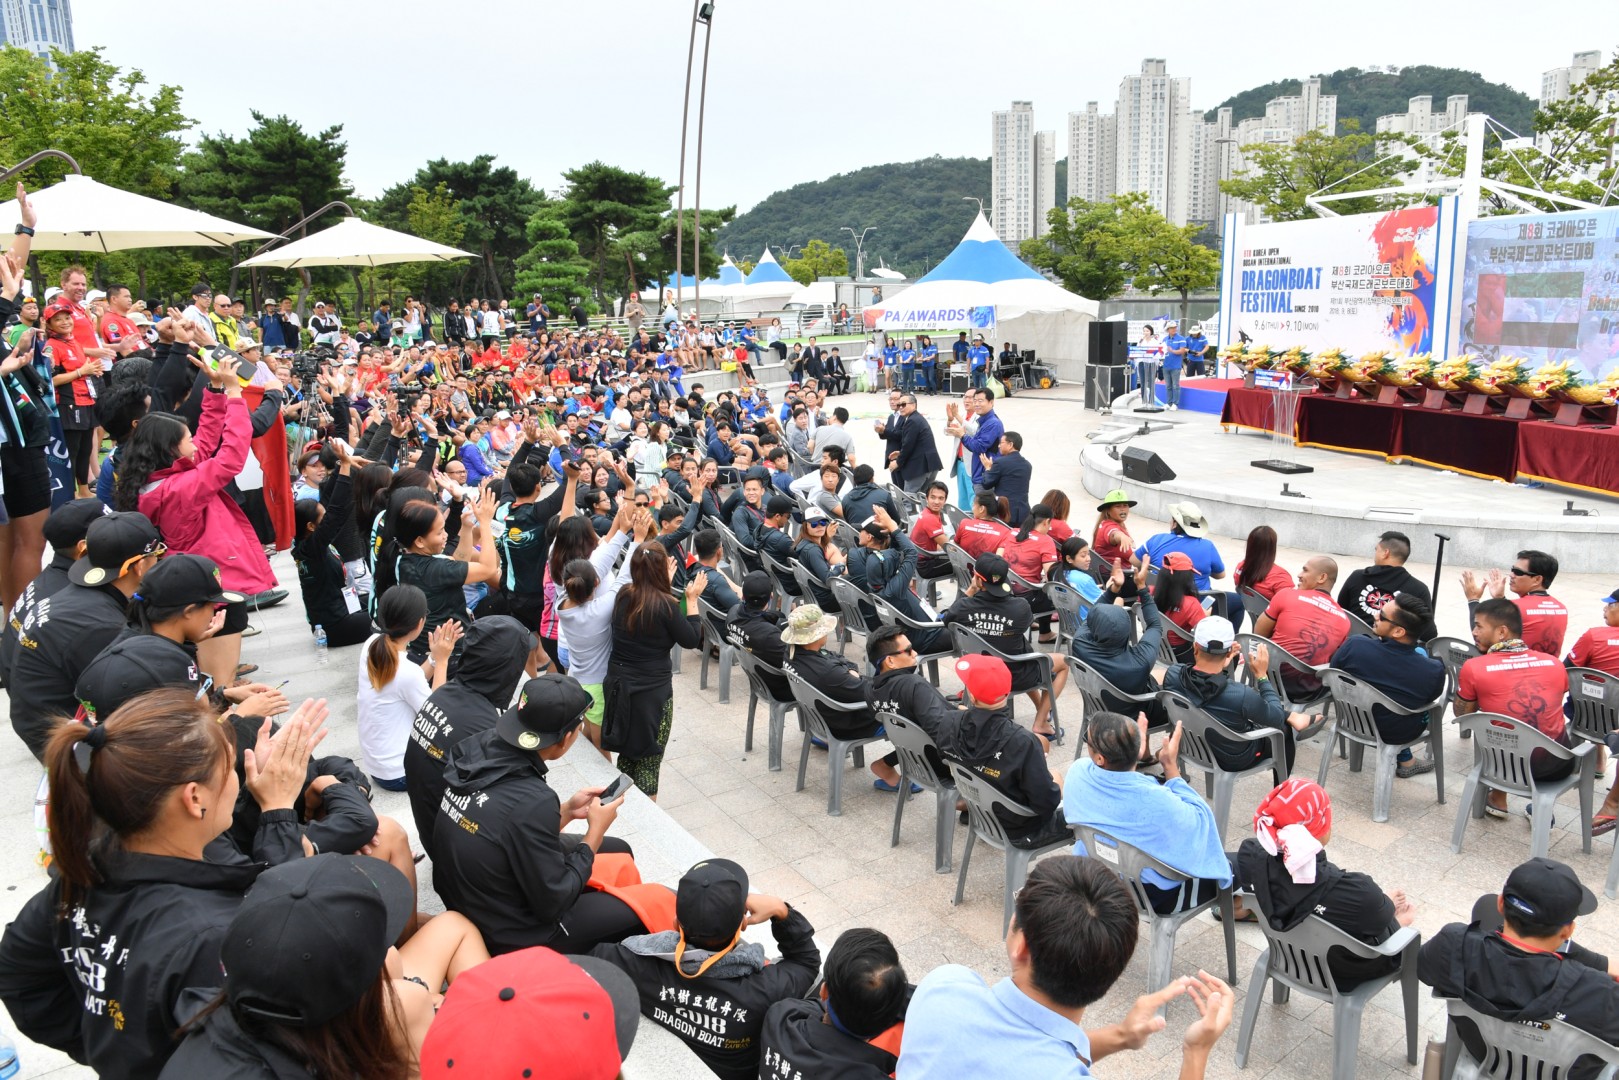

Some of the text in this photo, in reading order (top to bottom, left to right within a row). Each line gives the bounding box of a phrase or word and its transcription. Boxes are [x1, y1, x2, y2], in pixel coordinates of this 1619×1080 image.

[1517, 218, 1597, 240] 제8회 코리아오픈
[1253, 248, 1267, 257] KOREA
[1268, 247, 1280, 256] OPEN
[1258, 256, 1292, 266] INTERNATIONAL
[1489, 242, 1594, 263] 부산국제드래곤보트대회
[1241, 266, 1324, 291] DRAGONBOAT
[1331, 263, 1390, 276] 제8회 코리아오픈
[1331, 278, 1413, 290] 부산국제드래곤보트대회
[1240, 291, 1293, 313] FESTIVAL
[1294, 305, 1306, 313] SINCE
[975, 620, 1004, 632] 2018
[414, 712, 438, 740] 2018
[653, 1006, 725, 1048] DRAGON BOAT
